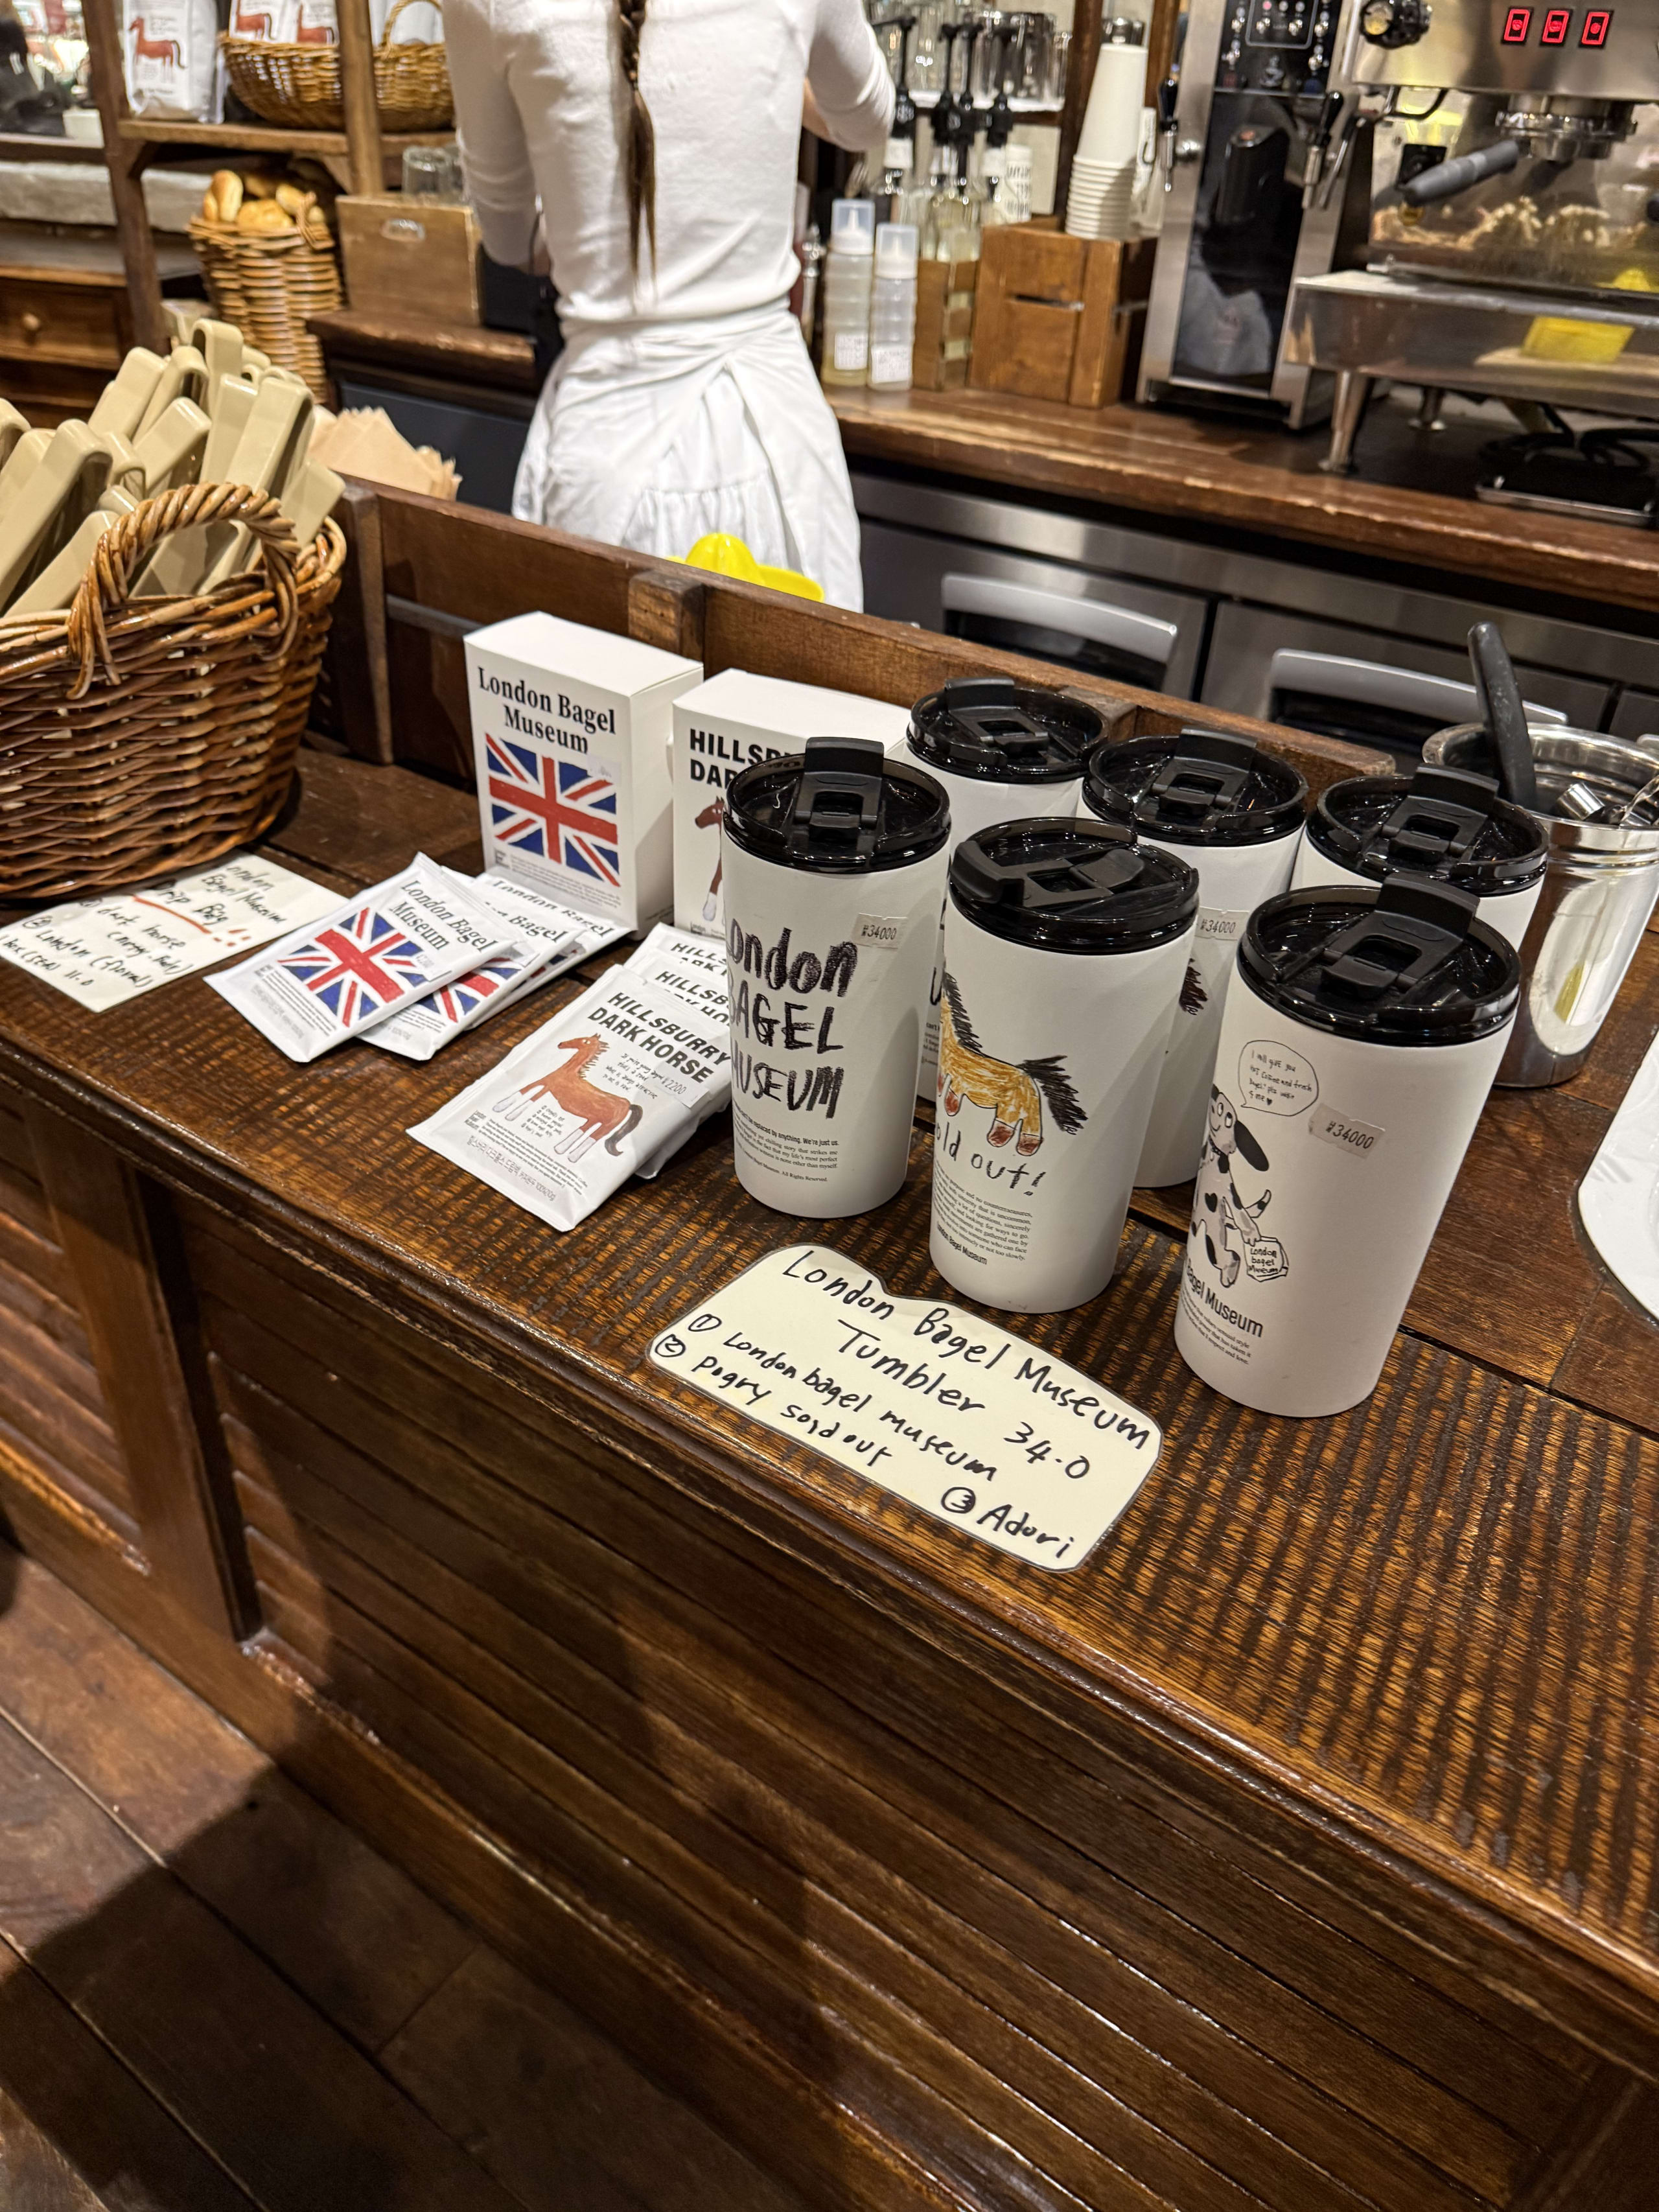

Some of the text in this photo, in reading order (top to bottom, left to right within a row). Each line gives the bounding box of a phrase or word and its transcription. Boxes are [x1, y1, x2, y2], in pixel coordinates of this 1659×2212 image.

[478, 666, 616, 735] London Bagel
[504, 704, 588, 754] Museum
[690, 758, 741, 789] DAR
[389, 901, 450, 951] Museum
[401, 880, 455, 920] London
[447, 918, 499, 952] Bagel
[509, 916, 569, 944] Bagel
[655, 971, 730, 1010] HILLSB
[727, 918, 858, 997] ondon
[587, 1007, 647, 1043] DARK
[638, 1034, 715, 1084] HORSE
[607, 992, 732, 1065] HILLSBURRY
[936, 1122, 961, 1162] old
[971, 1154, 1047, 1196] out!
[1205, 1287, 1264, 1338] Museum
[782, 1250, 1152, 1450] London Bagel Museum
[837, 1320, 986, 1412] Tumbler
[723, 1332, 797, 1379] London
[802, 1368, 872, 1413] bagel
[879, 1409, 997, 1482] museum
[976, 1504, 1074, 1559] Adori
